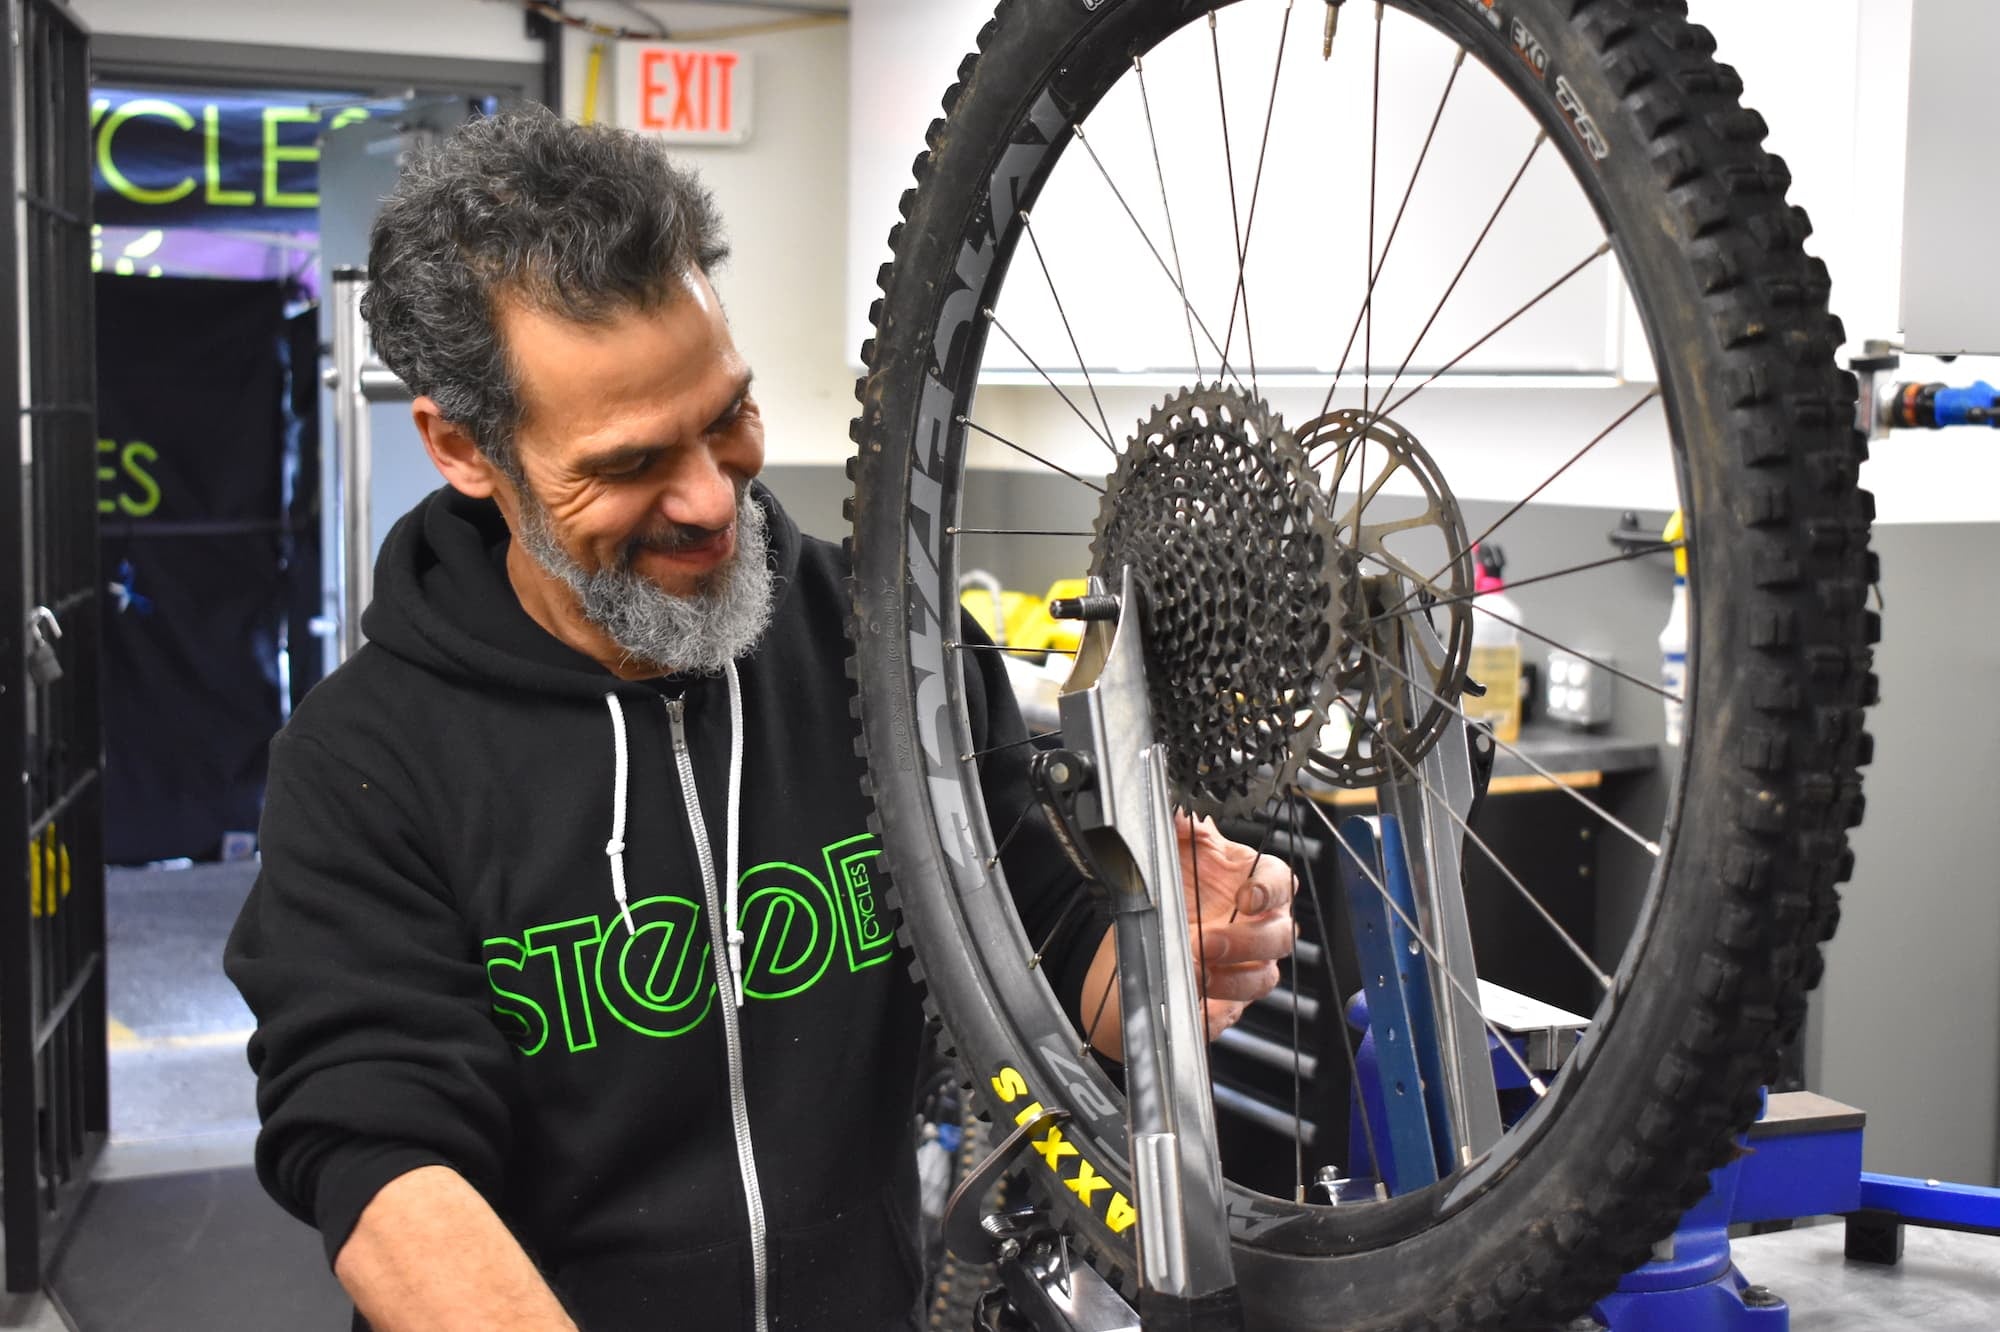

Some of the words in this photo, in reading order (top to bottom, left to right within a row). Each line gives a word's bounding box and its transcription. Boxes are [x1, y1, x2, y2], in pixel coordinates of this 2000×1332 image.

[640, 49, 739, 131] EXIT
[91, 99, 370, 208] CLE
[850, 862, 880, 939] CYCLES
